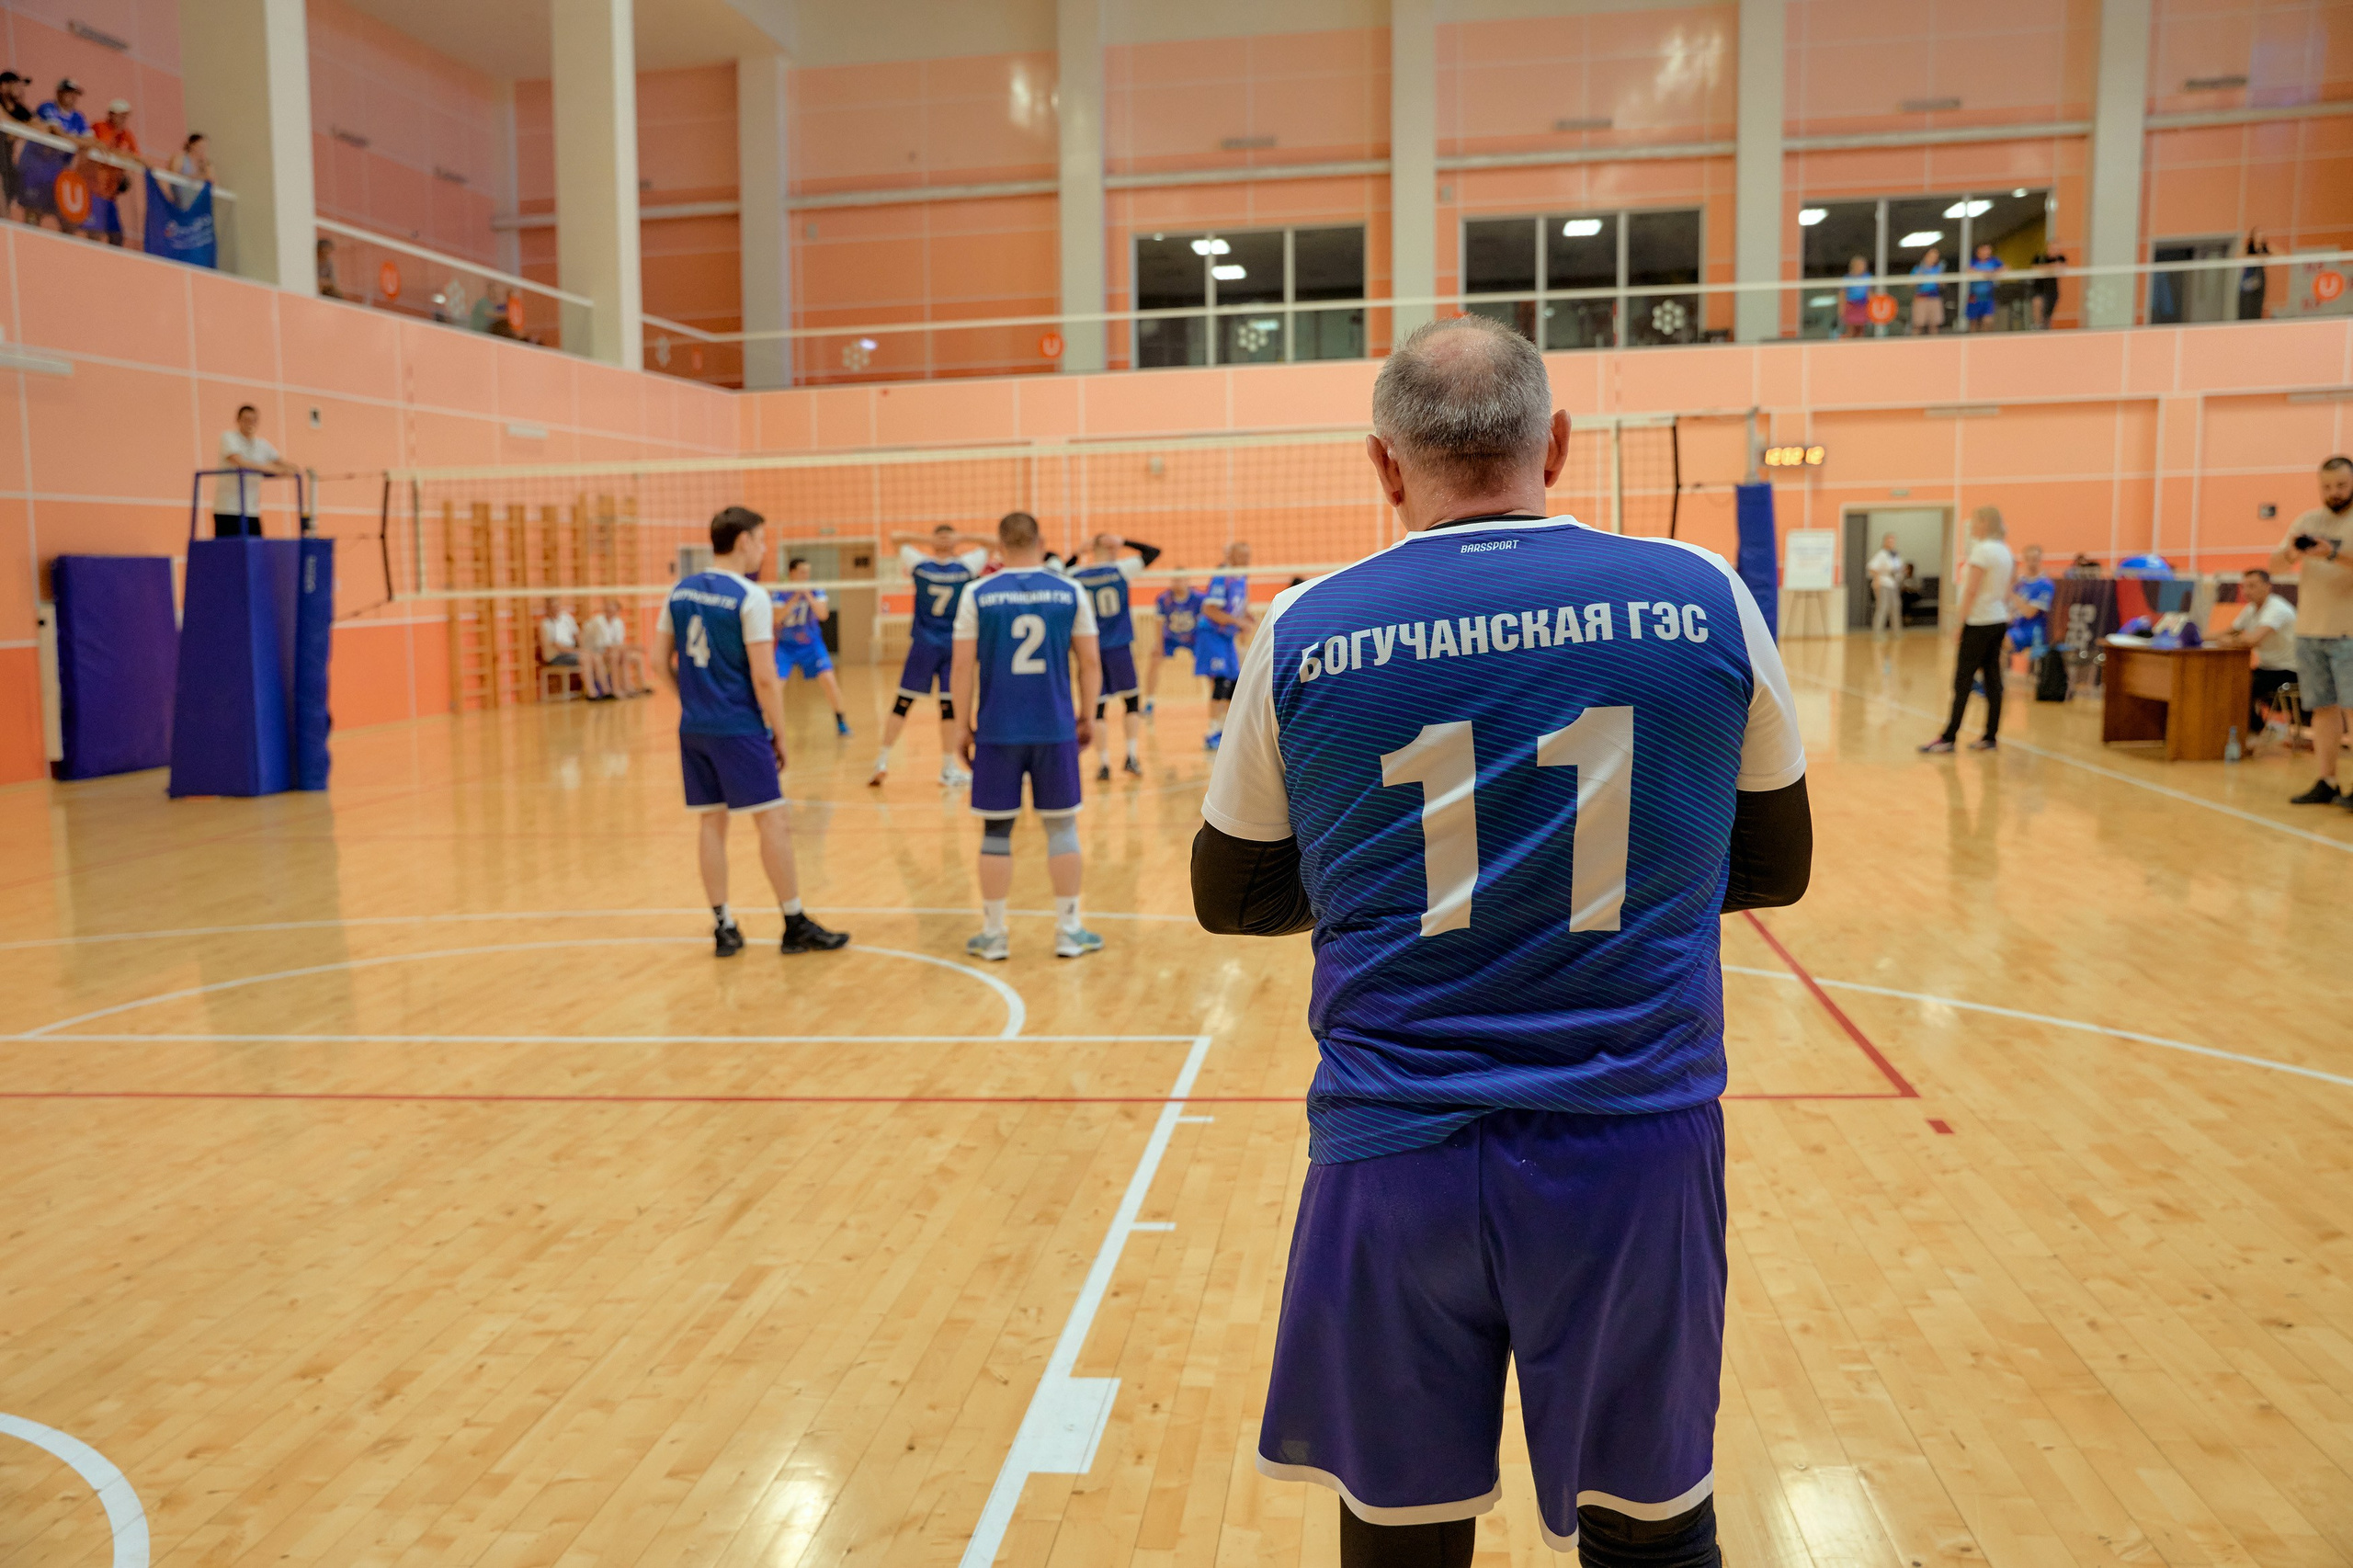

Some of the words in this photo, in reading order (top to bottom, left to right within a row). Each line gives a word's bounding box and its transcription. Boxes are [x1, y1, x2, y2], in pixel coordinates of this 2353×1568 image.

[1461, 540, 1519, 553] BARSSPORT
[927, 585, 954, 617] 7
[686, 614, 710, 668] 4
[1011, 613, 1046, 675] 2
[1299, 603, 1614, 683] БОГУЧАНСКАЯ
[1627, 601, 1709, 642] ГЭС
[1380, 705, 1634, 937] 11
